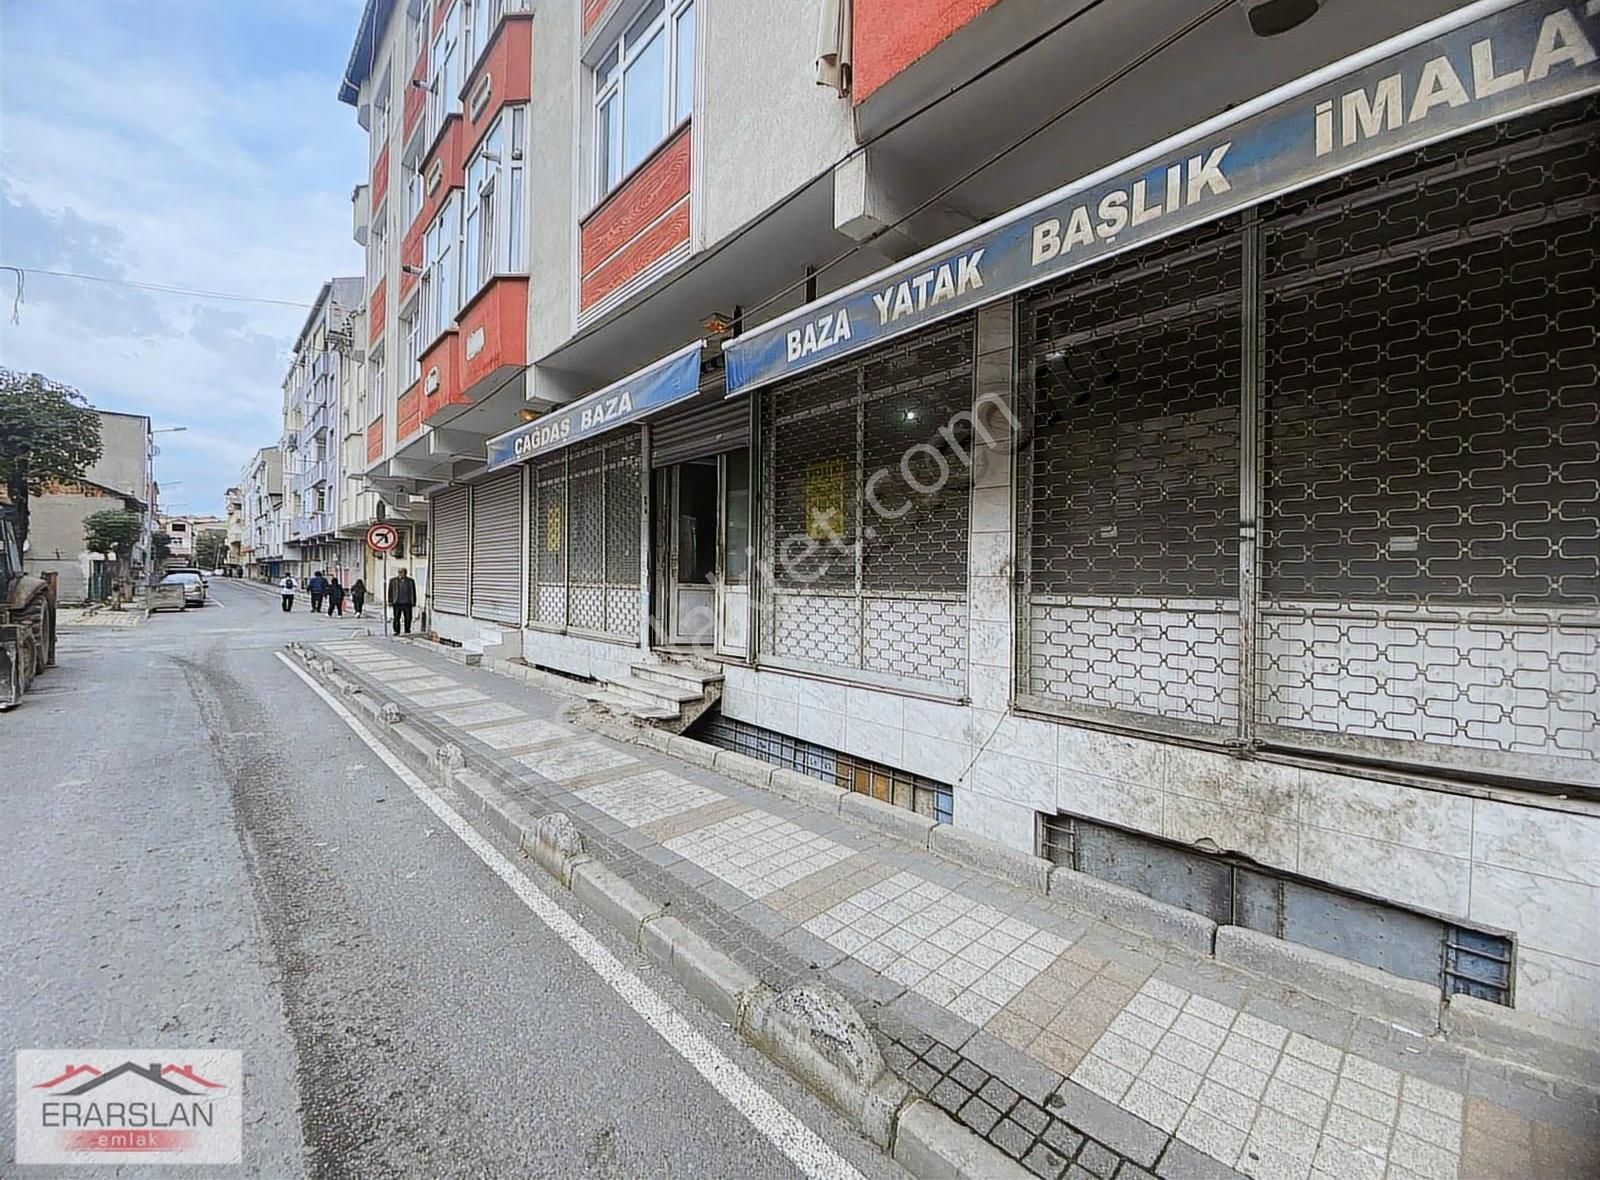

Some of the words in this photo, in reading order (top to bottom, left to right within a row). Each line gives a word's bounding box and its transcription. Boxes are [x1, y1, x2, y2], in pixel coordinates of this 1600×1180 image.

[786, 308, 852, 363] BAZA
[873, 248, 985, 326] YATAK
[1032, 142, 1232, 267] BAŞLIK
[514, 417, 571, 459] ÇAĞDAŞ
[581, 391, 632, 431] BAZA
